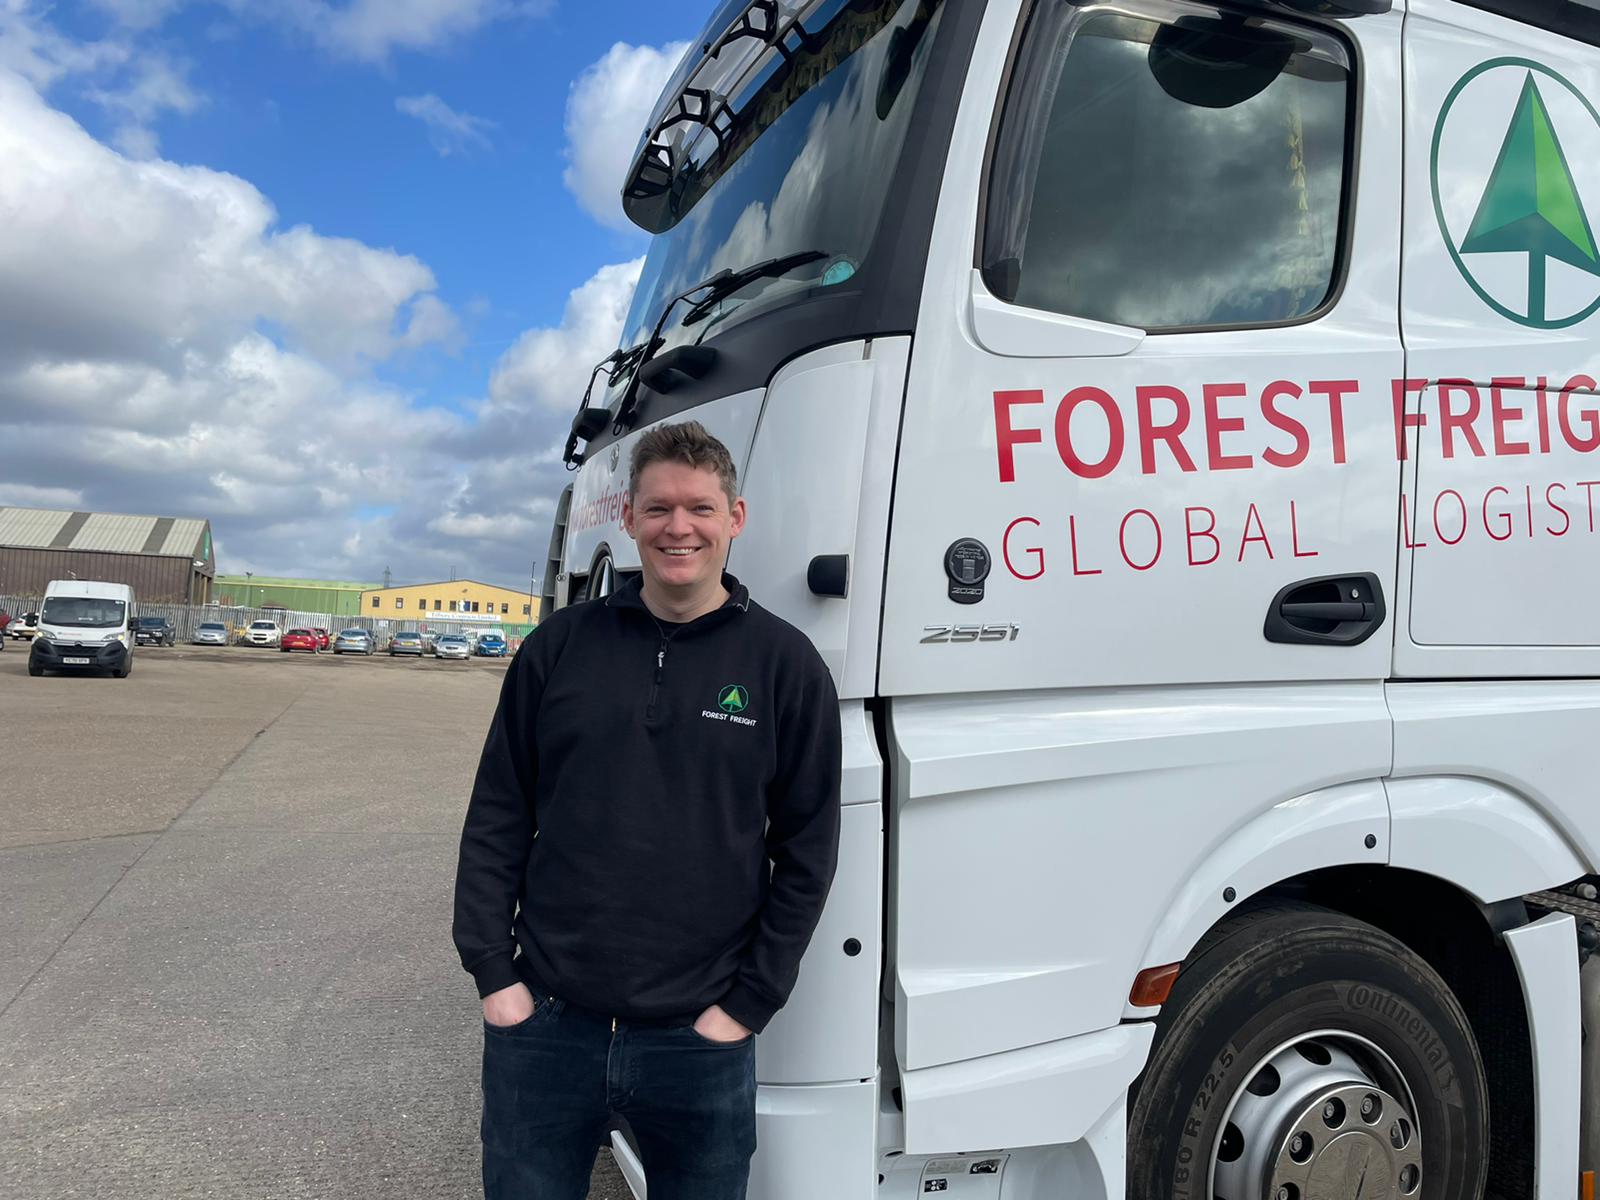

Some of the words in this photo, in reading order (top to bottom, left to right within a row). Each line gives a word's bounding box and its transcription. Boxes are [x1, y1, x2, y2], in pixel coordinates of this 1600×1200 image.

[993, 379, 1359, 482] FOREST
[1391, 374, 1600, 461] FREIG
[1003, 500, 1318, 580] GLOBAL
[1402, 481, 1600, 549] LOGIST
[951, 587, 983, 595] 2020
[701, 710, 728, 721] FOREST
[729, 715, 757, 727] FREIGHT
[1347, 985, 1455, 1090] Continental
[1195, 1048, 1234, 1111] 22.5
